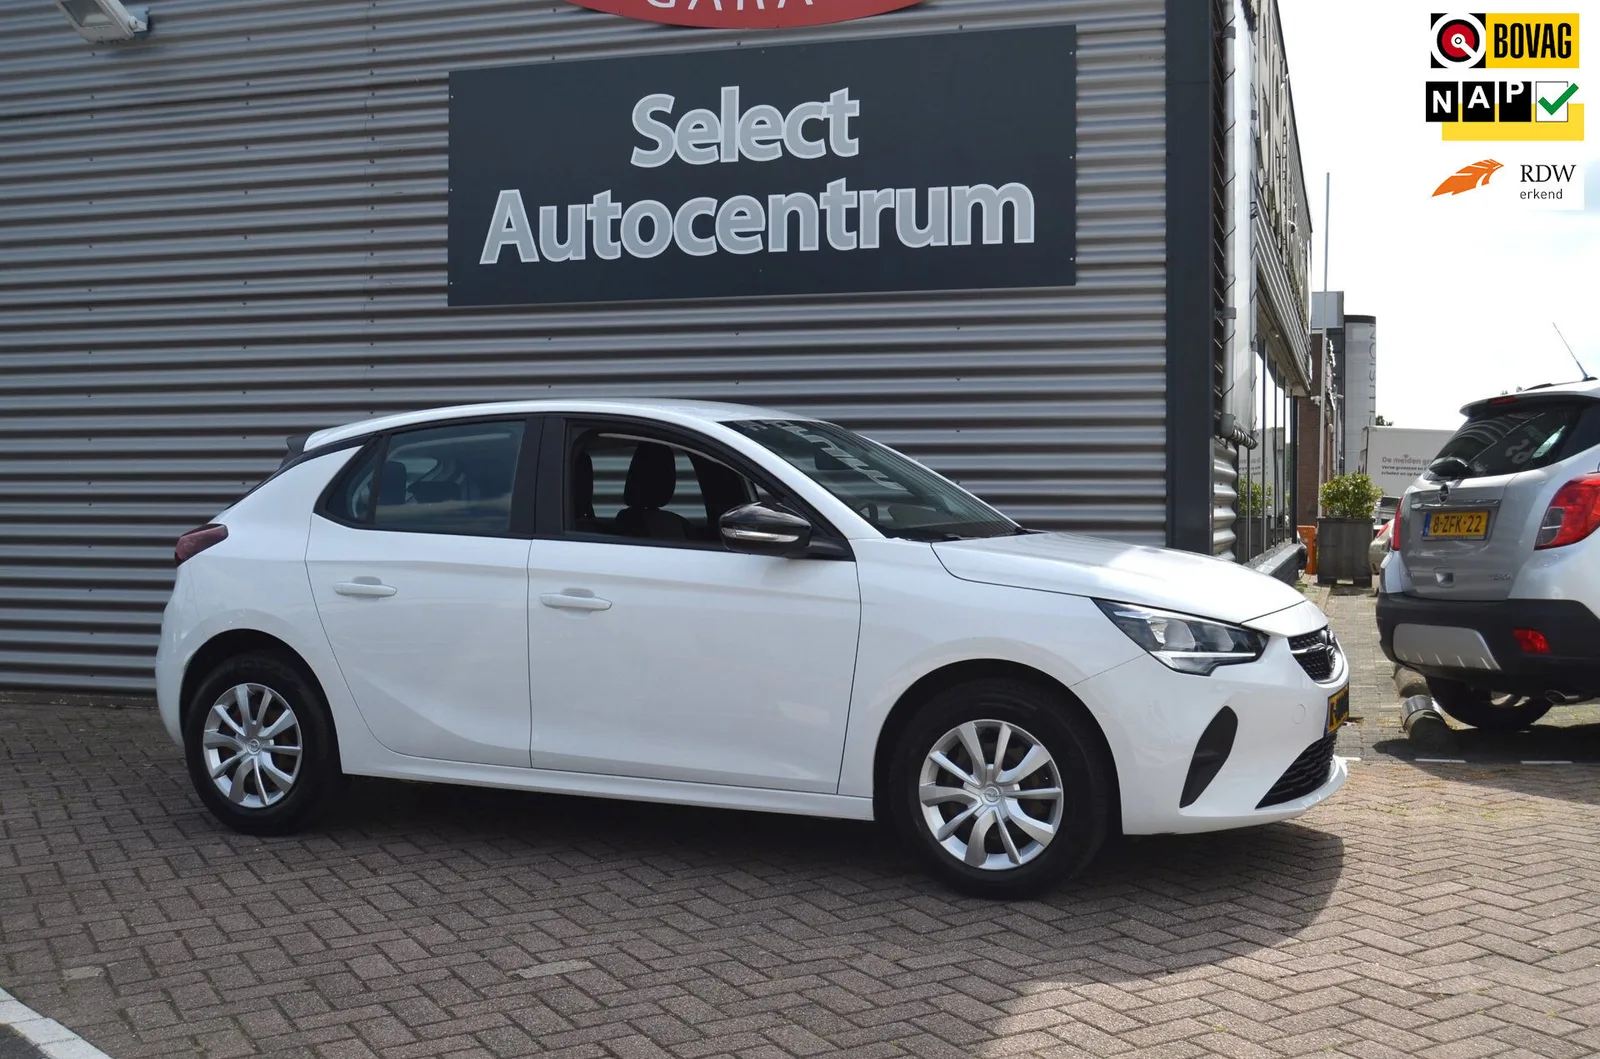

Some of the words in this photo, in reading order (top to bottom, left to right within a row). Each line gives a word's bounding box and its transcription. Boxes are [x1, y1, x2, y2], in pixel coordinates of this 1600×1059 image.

[630, 86, 859, 168] Select
[479, 178, 1035, 264] Autocentrum
[1432, 515, 1482, 534] 8-ZFK-22
